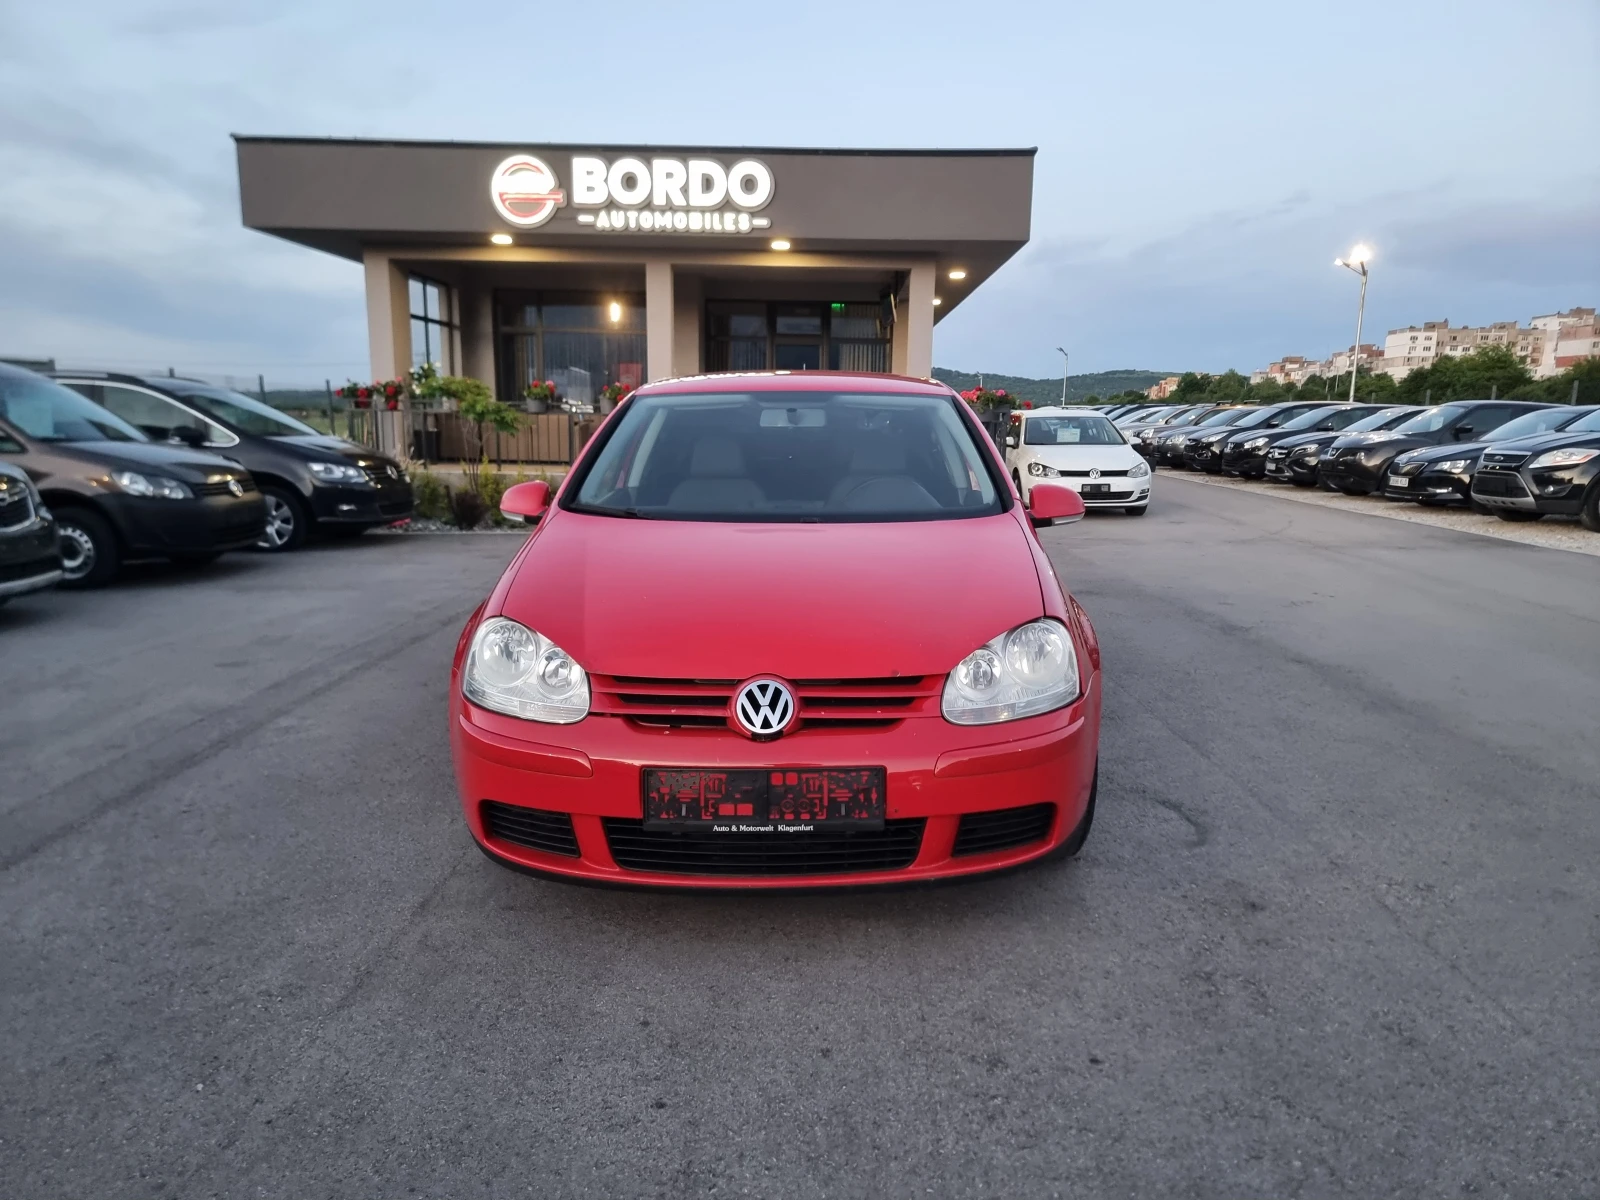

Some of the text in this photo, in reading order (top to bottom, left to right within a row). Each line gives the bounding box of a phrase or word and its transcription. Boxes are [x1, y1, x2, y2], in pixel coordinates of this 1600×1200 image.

[572, 157, 771, 207] BORDO
[712, 823, 814, 833] Auto & Motorwelt Klagenfurt
